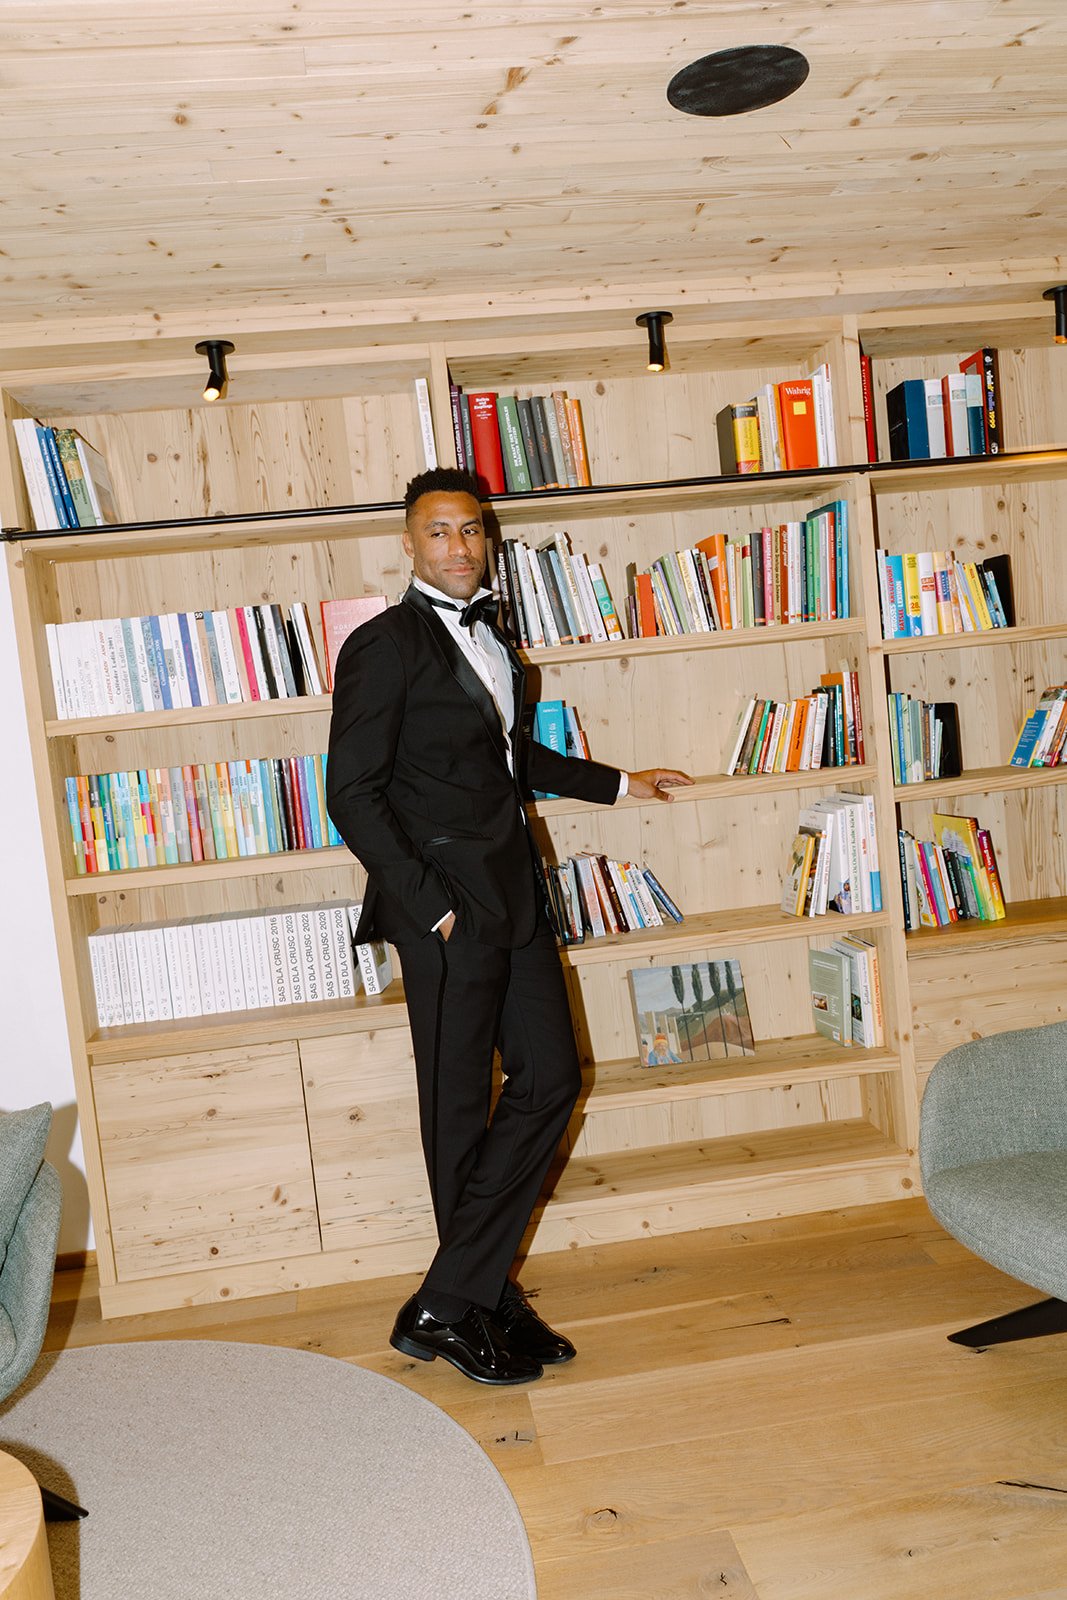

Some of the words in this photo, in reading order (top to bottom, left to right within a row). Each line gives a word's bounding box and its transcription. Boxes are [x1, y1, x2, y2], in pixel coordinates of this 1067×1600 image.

[785, 387, 811, 396] Wahrig
[498, 553, 506, 580] Grillen
[885, 565, 895, 603] KREUZWORT
[895, 580, 903, 607] LEXIKON
[118, 646, 126, 667] Ladin
[269, 917, 278, 935] 2016
[285, 915, 294, 934] 2023
[301, 913, 310, 932] 2022
[272, 937, 282, 965] CRUSC
[287, 935, 298, 964] CRUSC
[304, 934, 314, 963] CRUSC
[320, 932, 331, 961] CRUSC
[337, 930, 347, 959] CRUSC
[291, 966, 300, 982] DLA
[307, 965, 316, 981] DLA
[324, 962, 333, 979] DLA
[340, 960, 349, 977] DLA
[363, 957, 372, 974] DLA
[275, 968, 284, 984] DLA
[366, 976, 376, 992] SAS
[278, 986, 287, 1002] SAS
[293, 985, 302, 1001] SAS
[310, 983, 319, 999] SAS
[326, 981, 335, 997] SAS
[343, 979, 351, 995] SAS
